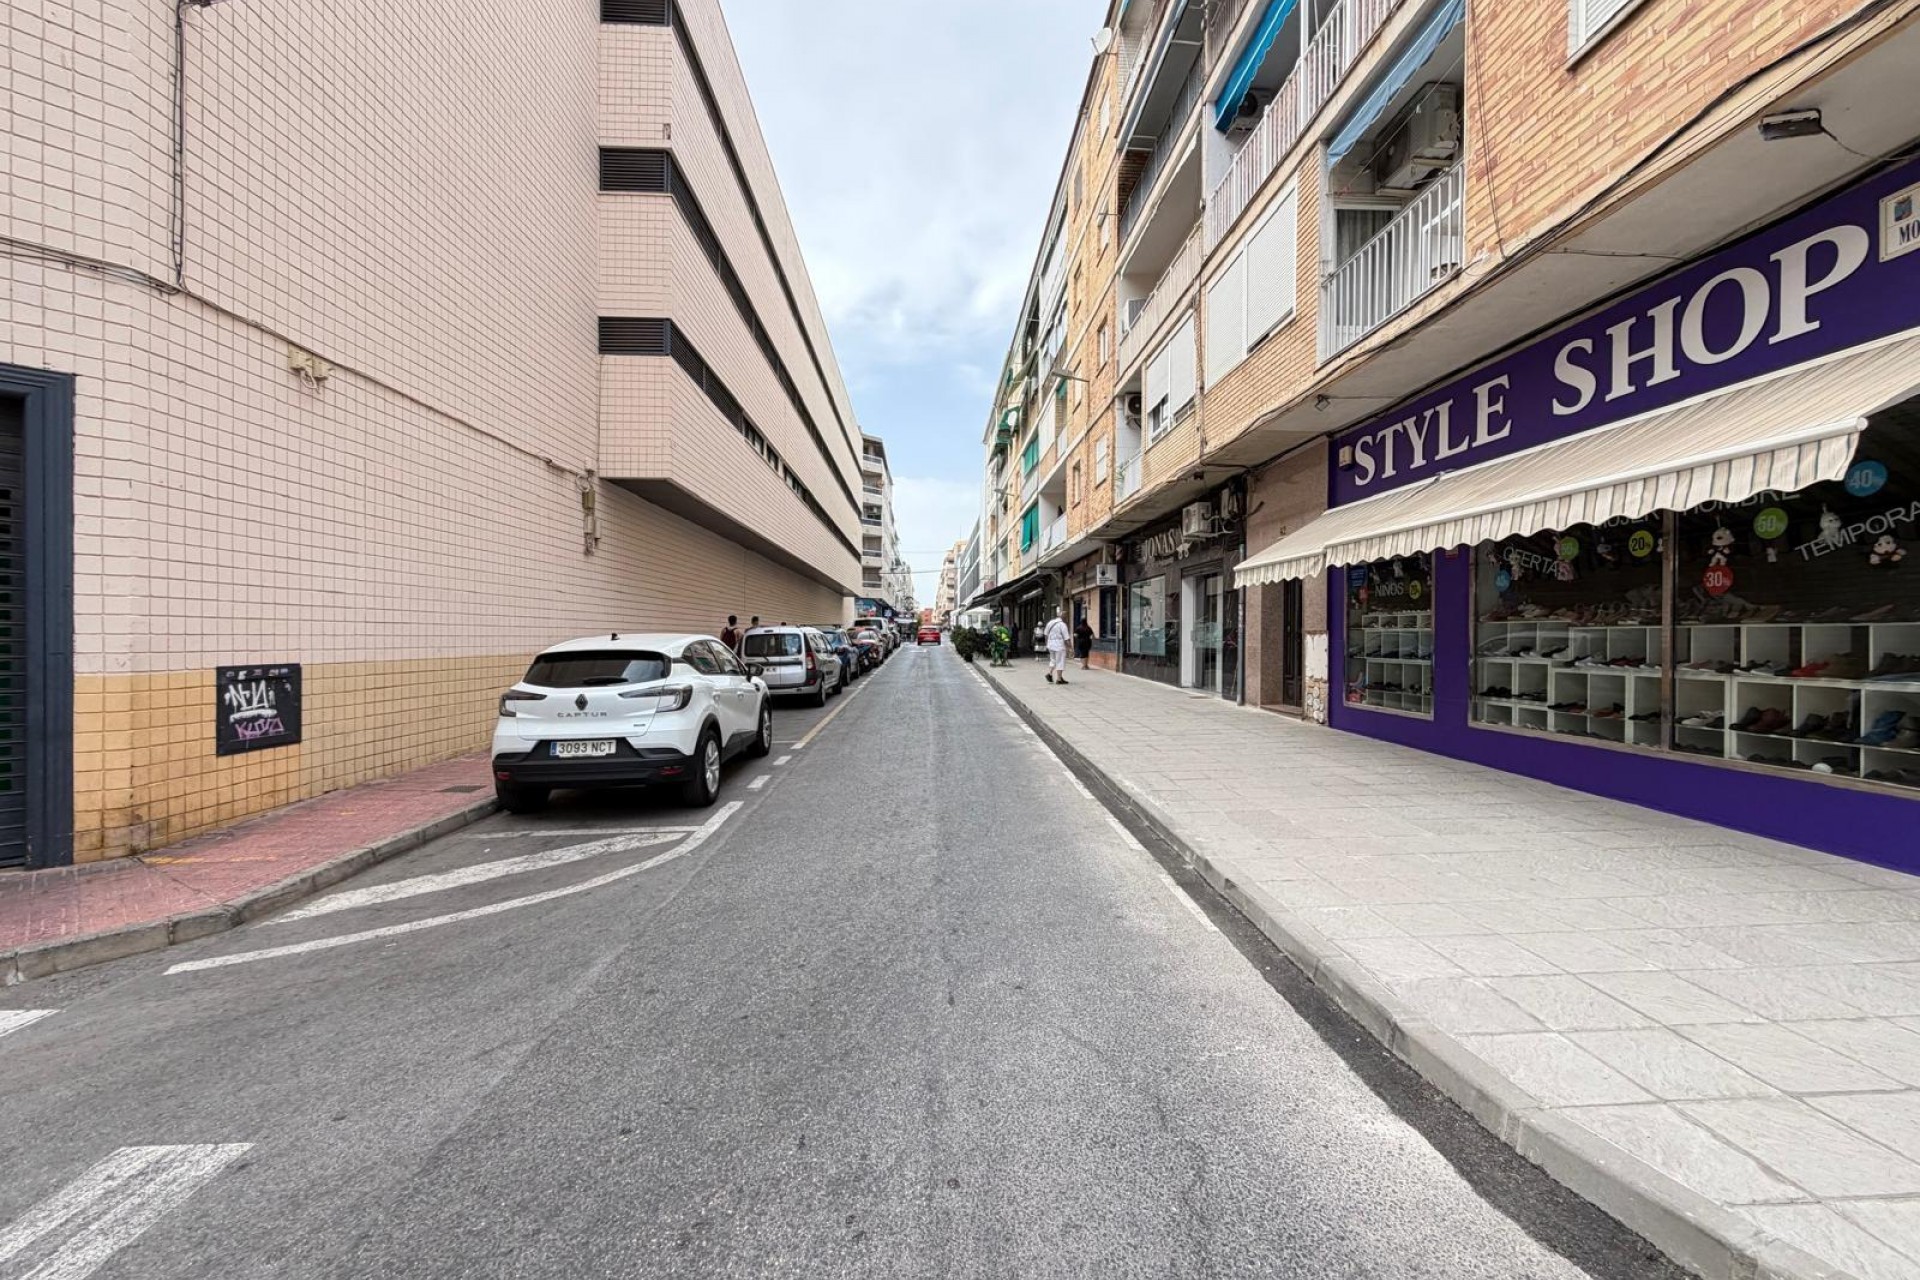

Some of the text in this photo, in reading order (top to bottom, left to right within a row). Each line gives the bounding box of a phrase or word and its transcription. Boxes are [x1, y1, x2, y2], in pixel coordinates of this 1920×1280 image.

[1354, 224, 1870, 487] STYLE SHOP
[1143, 528, 1175, 561] JONAS
[558, 741, 614, 754] 3093 NCT
